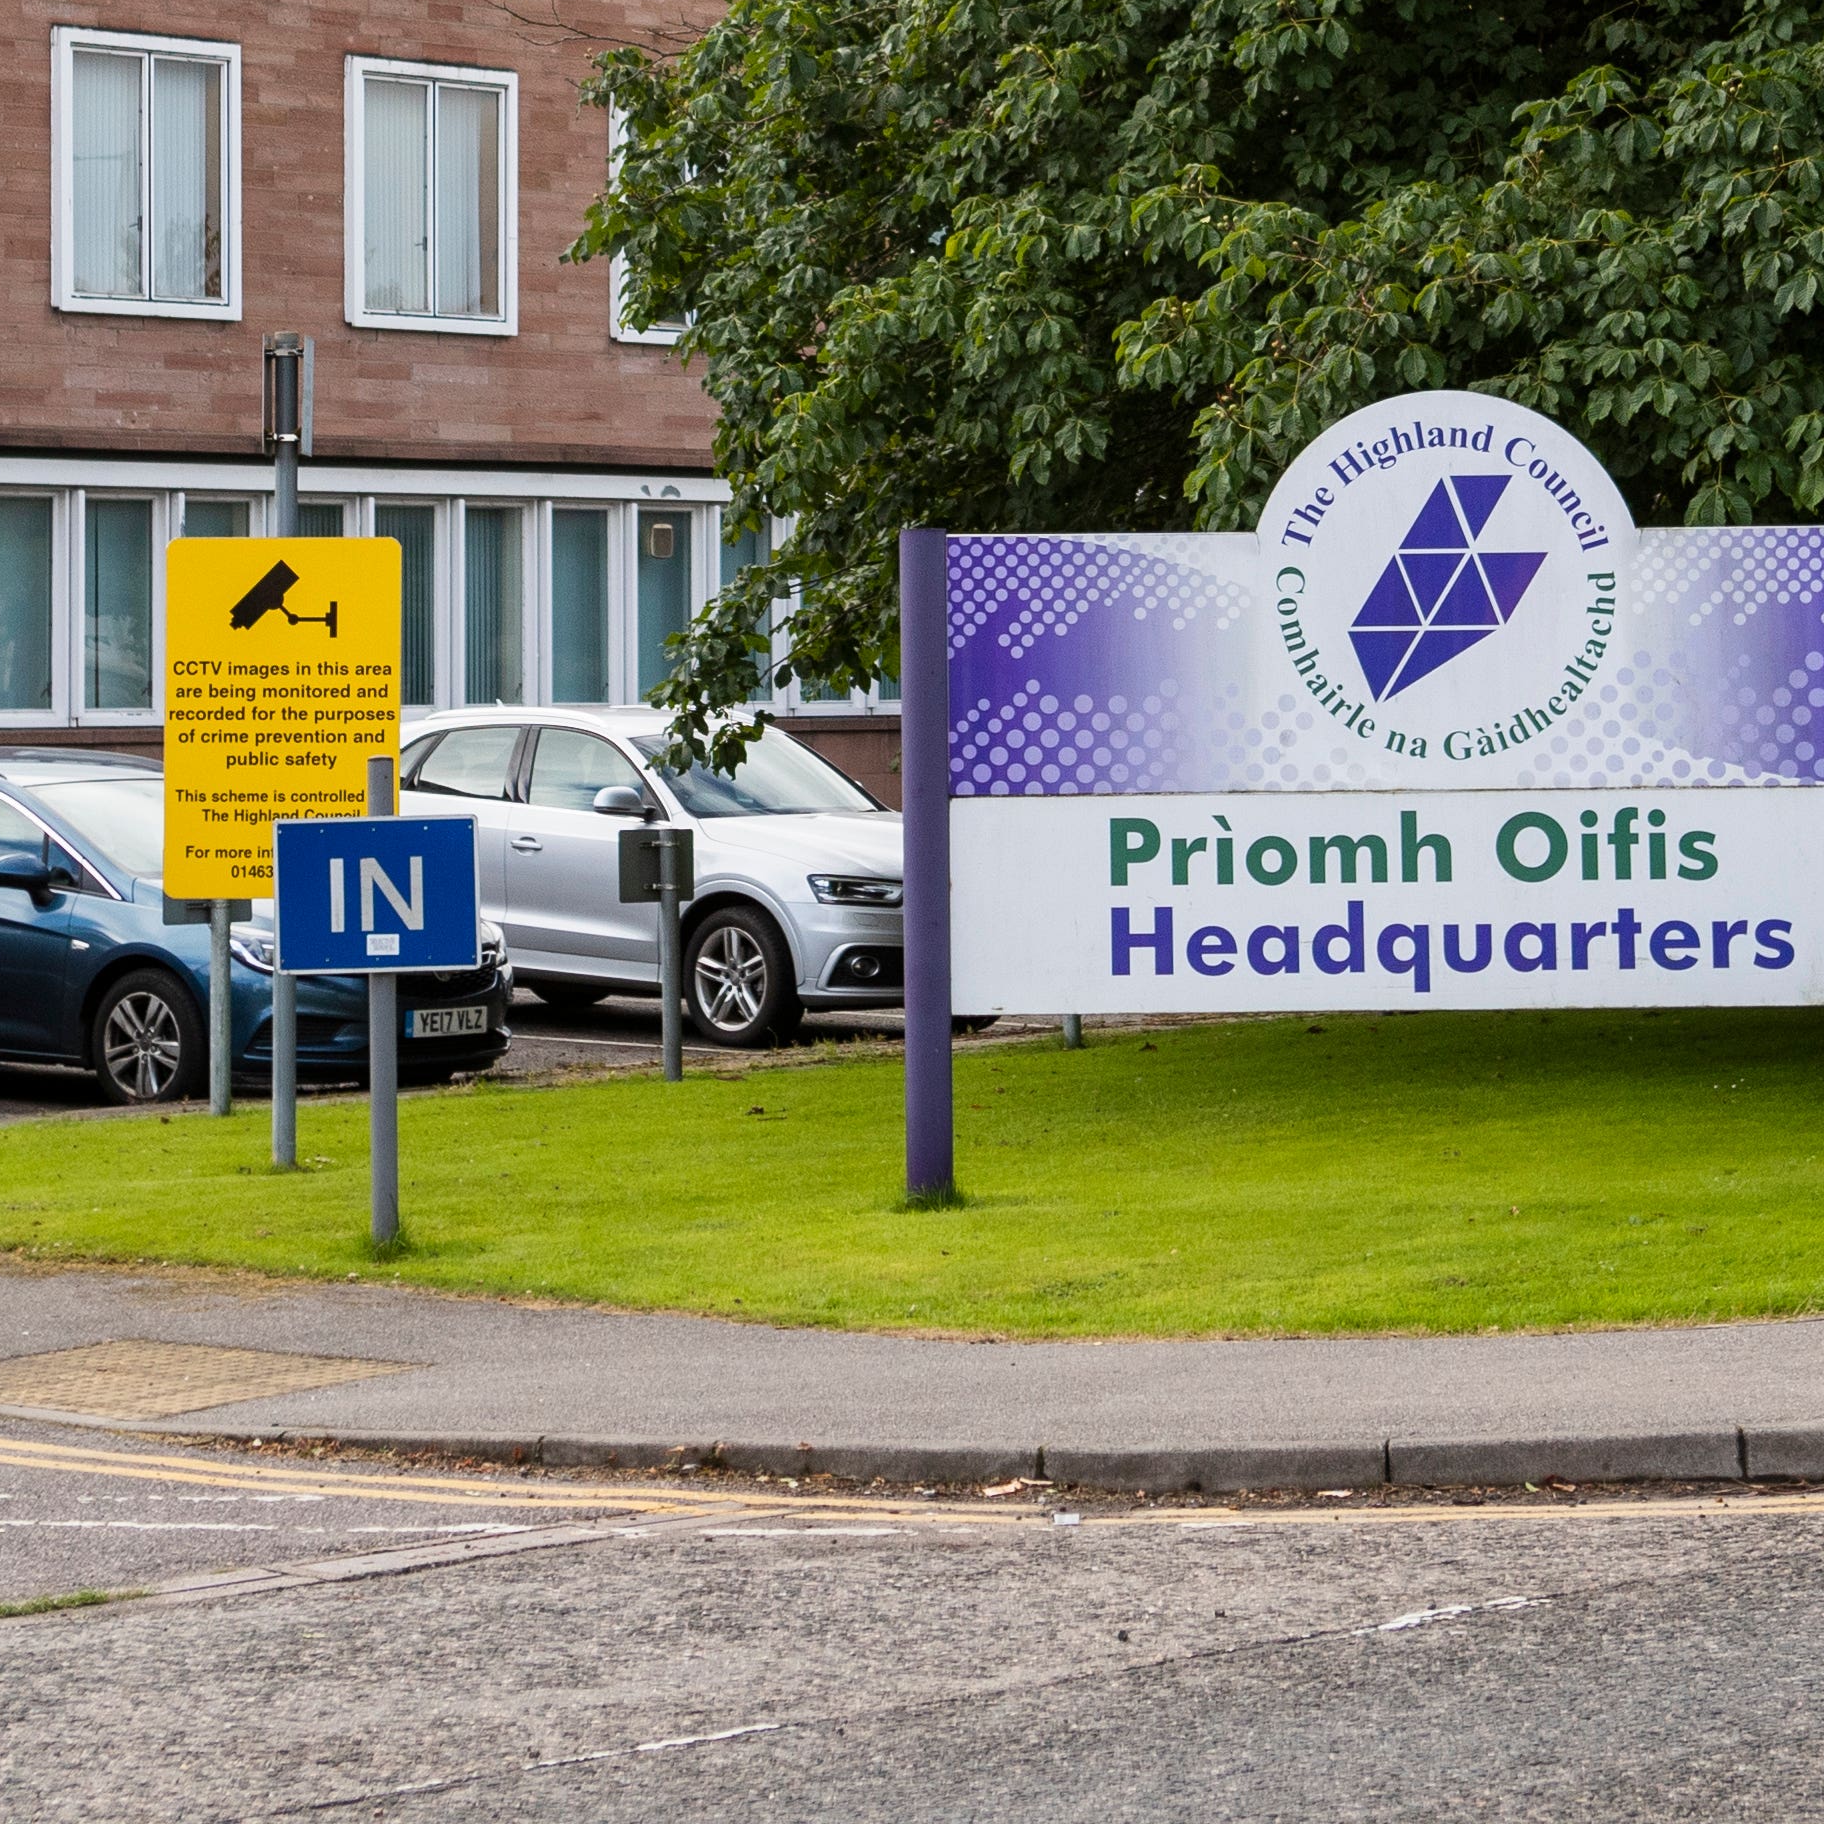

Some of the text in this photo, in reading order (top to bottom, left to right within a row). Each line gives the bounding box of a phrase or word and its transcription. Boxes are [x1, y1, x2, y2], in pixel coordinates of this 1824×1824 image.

[1281, 421, 1609, 552] The Highland Council
[173, 660, 392, 680] CCTV images in this area
[1276, 566, 1617, 762] Comhairle na Gàidhealtachd
[175, 683, 389, 702] are being monitored and
[169, 706, 396, 724] recorded for the purposes
[178, 728, 385, 747] of crime prevention and
[226, 751, 337, 770] public safety
[175, 789, 365, 803] This scheme is controlled
[201, 808, 229, 822] The
[234, 808, 299, 825] Highland
[185, 845, 211, 859] For
[214, 848, 253, 859] more
[1109, 806, 1720, 887] Prìomh Oifis
[230, 864, 273, 879] 01463
[329, 856, 424, 933] IN
[1110, 900, 1795, 993] Headquarters
[420, 1011, 453, 1033] YE17
